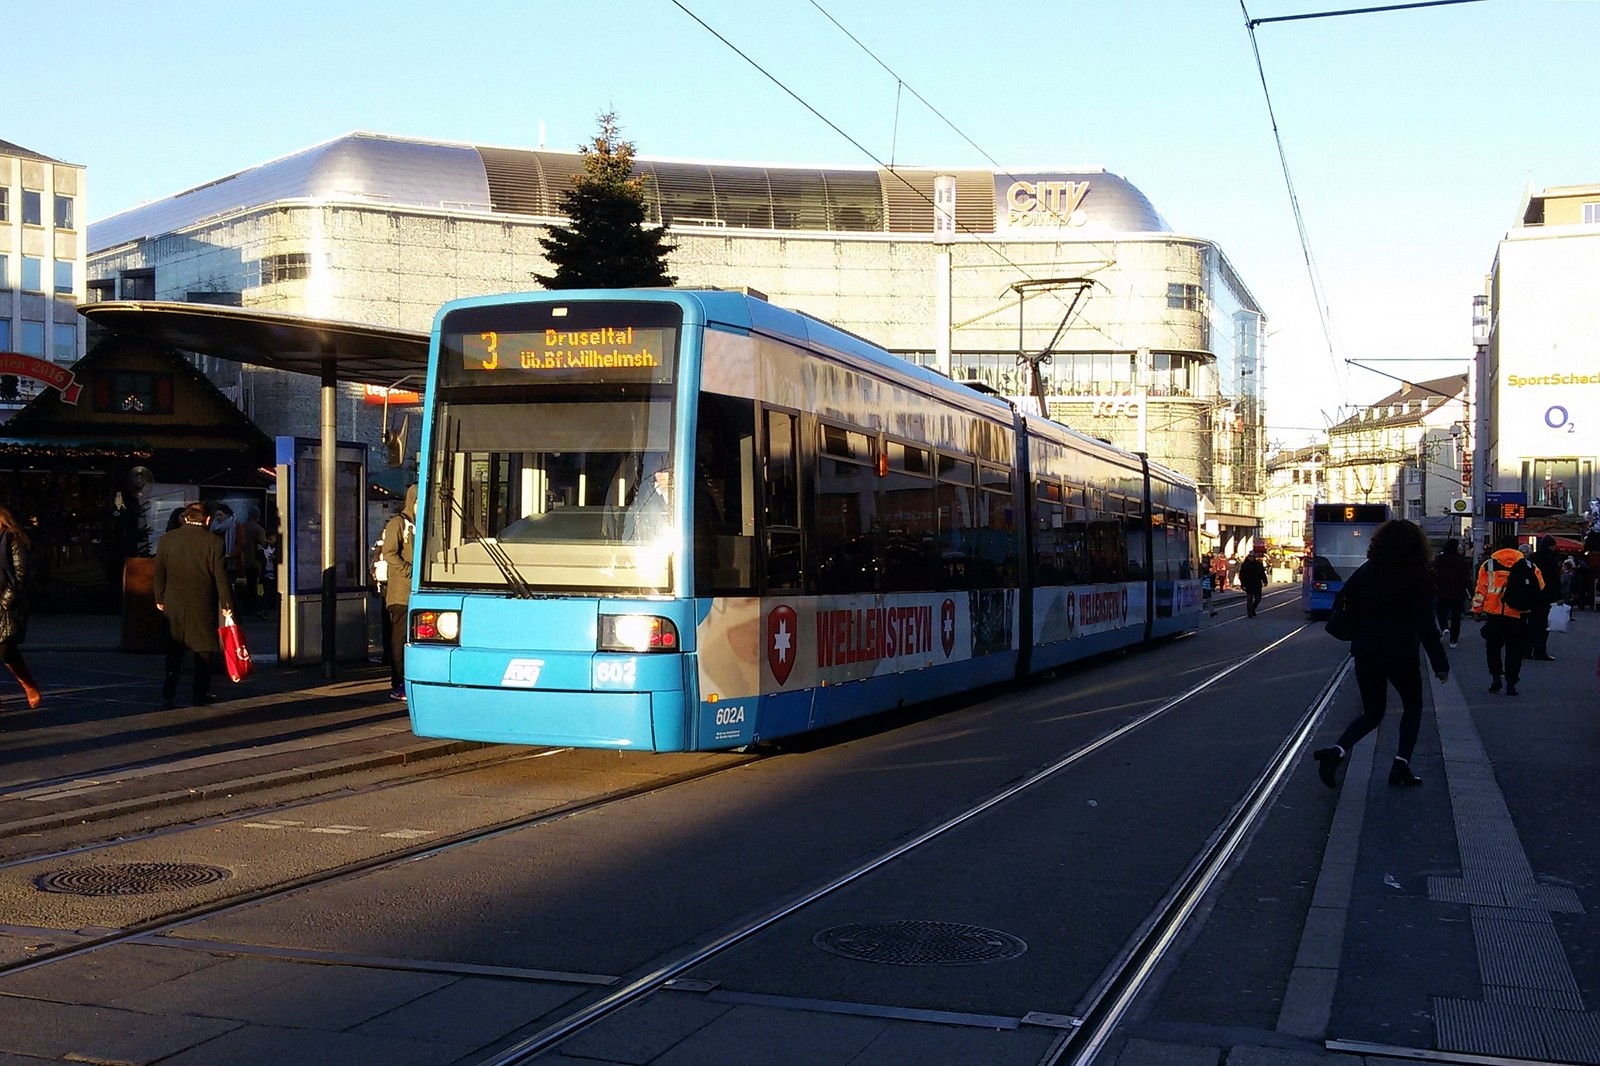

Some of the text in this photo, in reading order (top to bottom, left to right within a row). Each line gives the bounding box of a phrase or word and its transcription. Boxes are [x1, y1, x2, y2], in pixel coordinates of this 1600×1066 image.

[1007, 181, 1090, 225] CITY
[481, 327, 633, 370] 3 Druseltal
[32, 360, 65, 383] 2016
[1507, 373, 1600, 388] SportSchec
[1091, 401, 1139, 419] KFC
[1345, 507, 1354, 519] 5
[816, 605, 933, 668] WELLENSTEYN
[597, 660, 637, 683] 602
[716, 706, 745, 725] 602A
